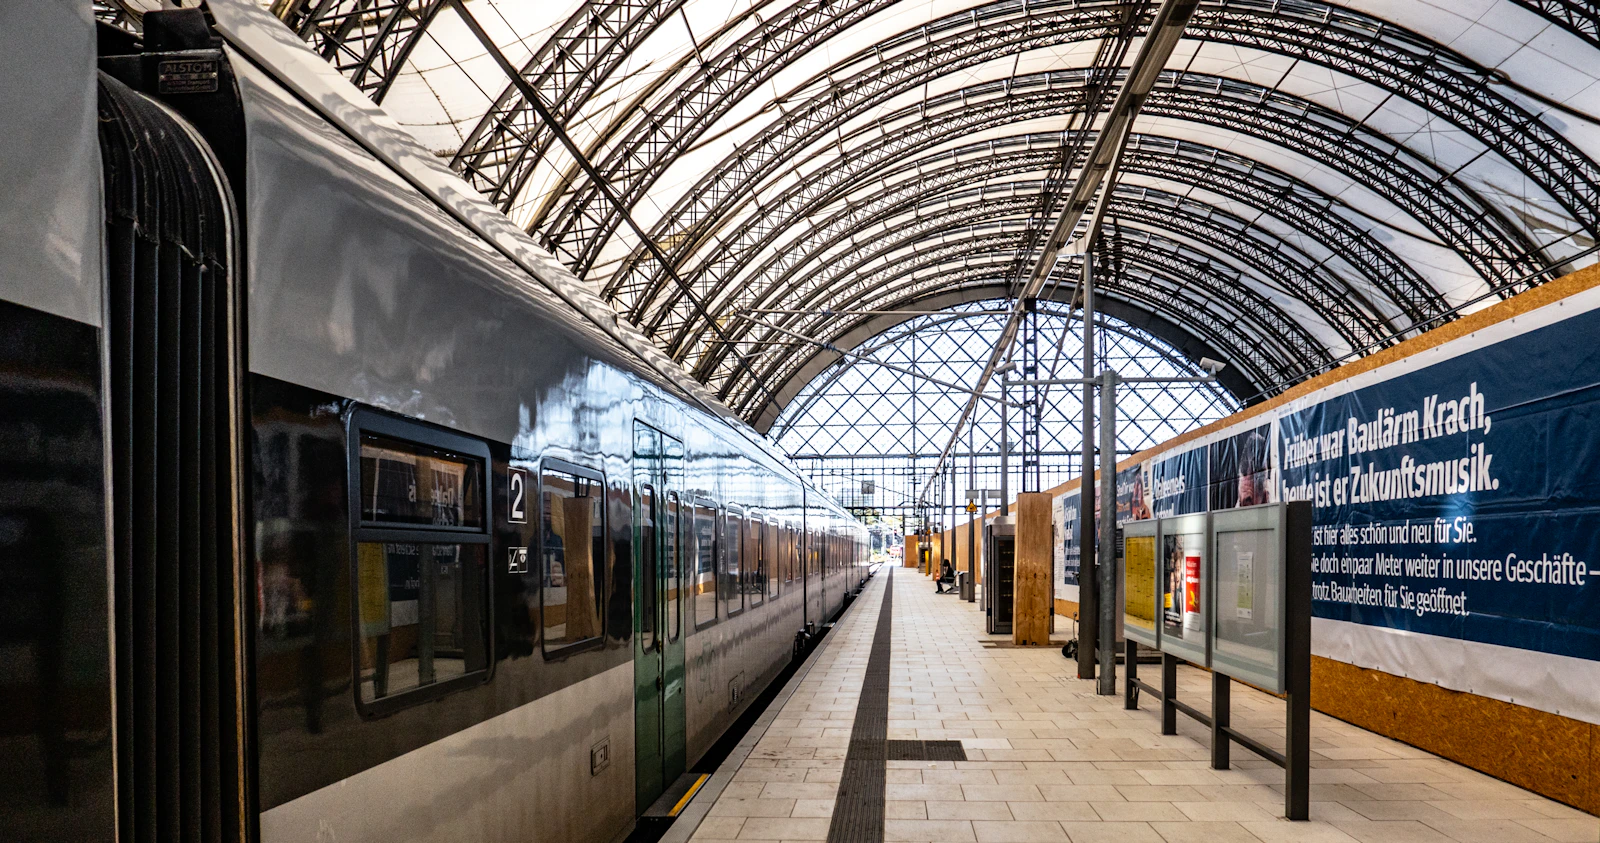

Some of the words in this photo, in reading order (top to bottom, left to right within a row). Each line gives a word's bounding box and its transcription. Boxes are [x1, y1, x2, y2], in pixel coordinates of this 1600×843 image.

[1283, 432, 1318, 471] Früher
[1320, 428, 1345, 457] war
[1347, 406, 1419, 455] Baulärm
[1423, 381, 1492, 435] Krach,
[510, 472, 524, 519] 2
[1314, 471, 1331, 509] ist
[1332, 478, 1349, 507] er
[1350, 442, 1500, 504] Zukunftsmusik.
[1313, 525, 1323, 546] ist
[1324, 525, 1338, 545] hier
[1340, 523, 1359, 545] alles
[1360, 521, 1387, 545] schön
[1389, 518, 1409, 544] und
[1411, 524, 1432, 544] neu
[1434, 517, 1452, 543] für
[1453, 516, 1477, 544] Sie.
[1311, 552, 1319, 573] ie
[1320, 552, 1339, 574] doch
[1341, 552, 1352, 574] ein
[1352, 557, 1374, 579] paar
[1375, 552, 1403, 577] Meter
[1405, 552, 1440, 579] weiter
[1443, 553, 1454, 579] in
[1456, 559, 1502, 582] unsere
[1505, 552, 1586, 586] Geschäfte
[1312, 580, 1330, 601] trotz
[1384, 583, 1398, 609] für
[1399, 585, 1416, 611] Sie
[1416, 587, 1470, 617] geöffnet.
